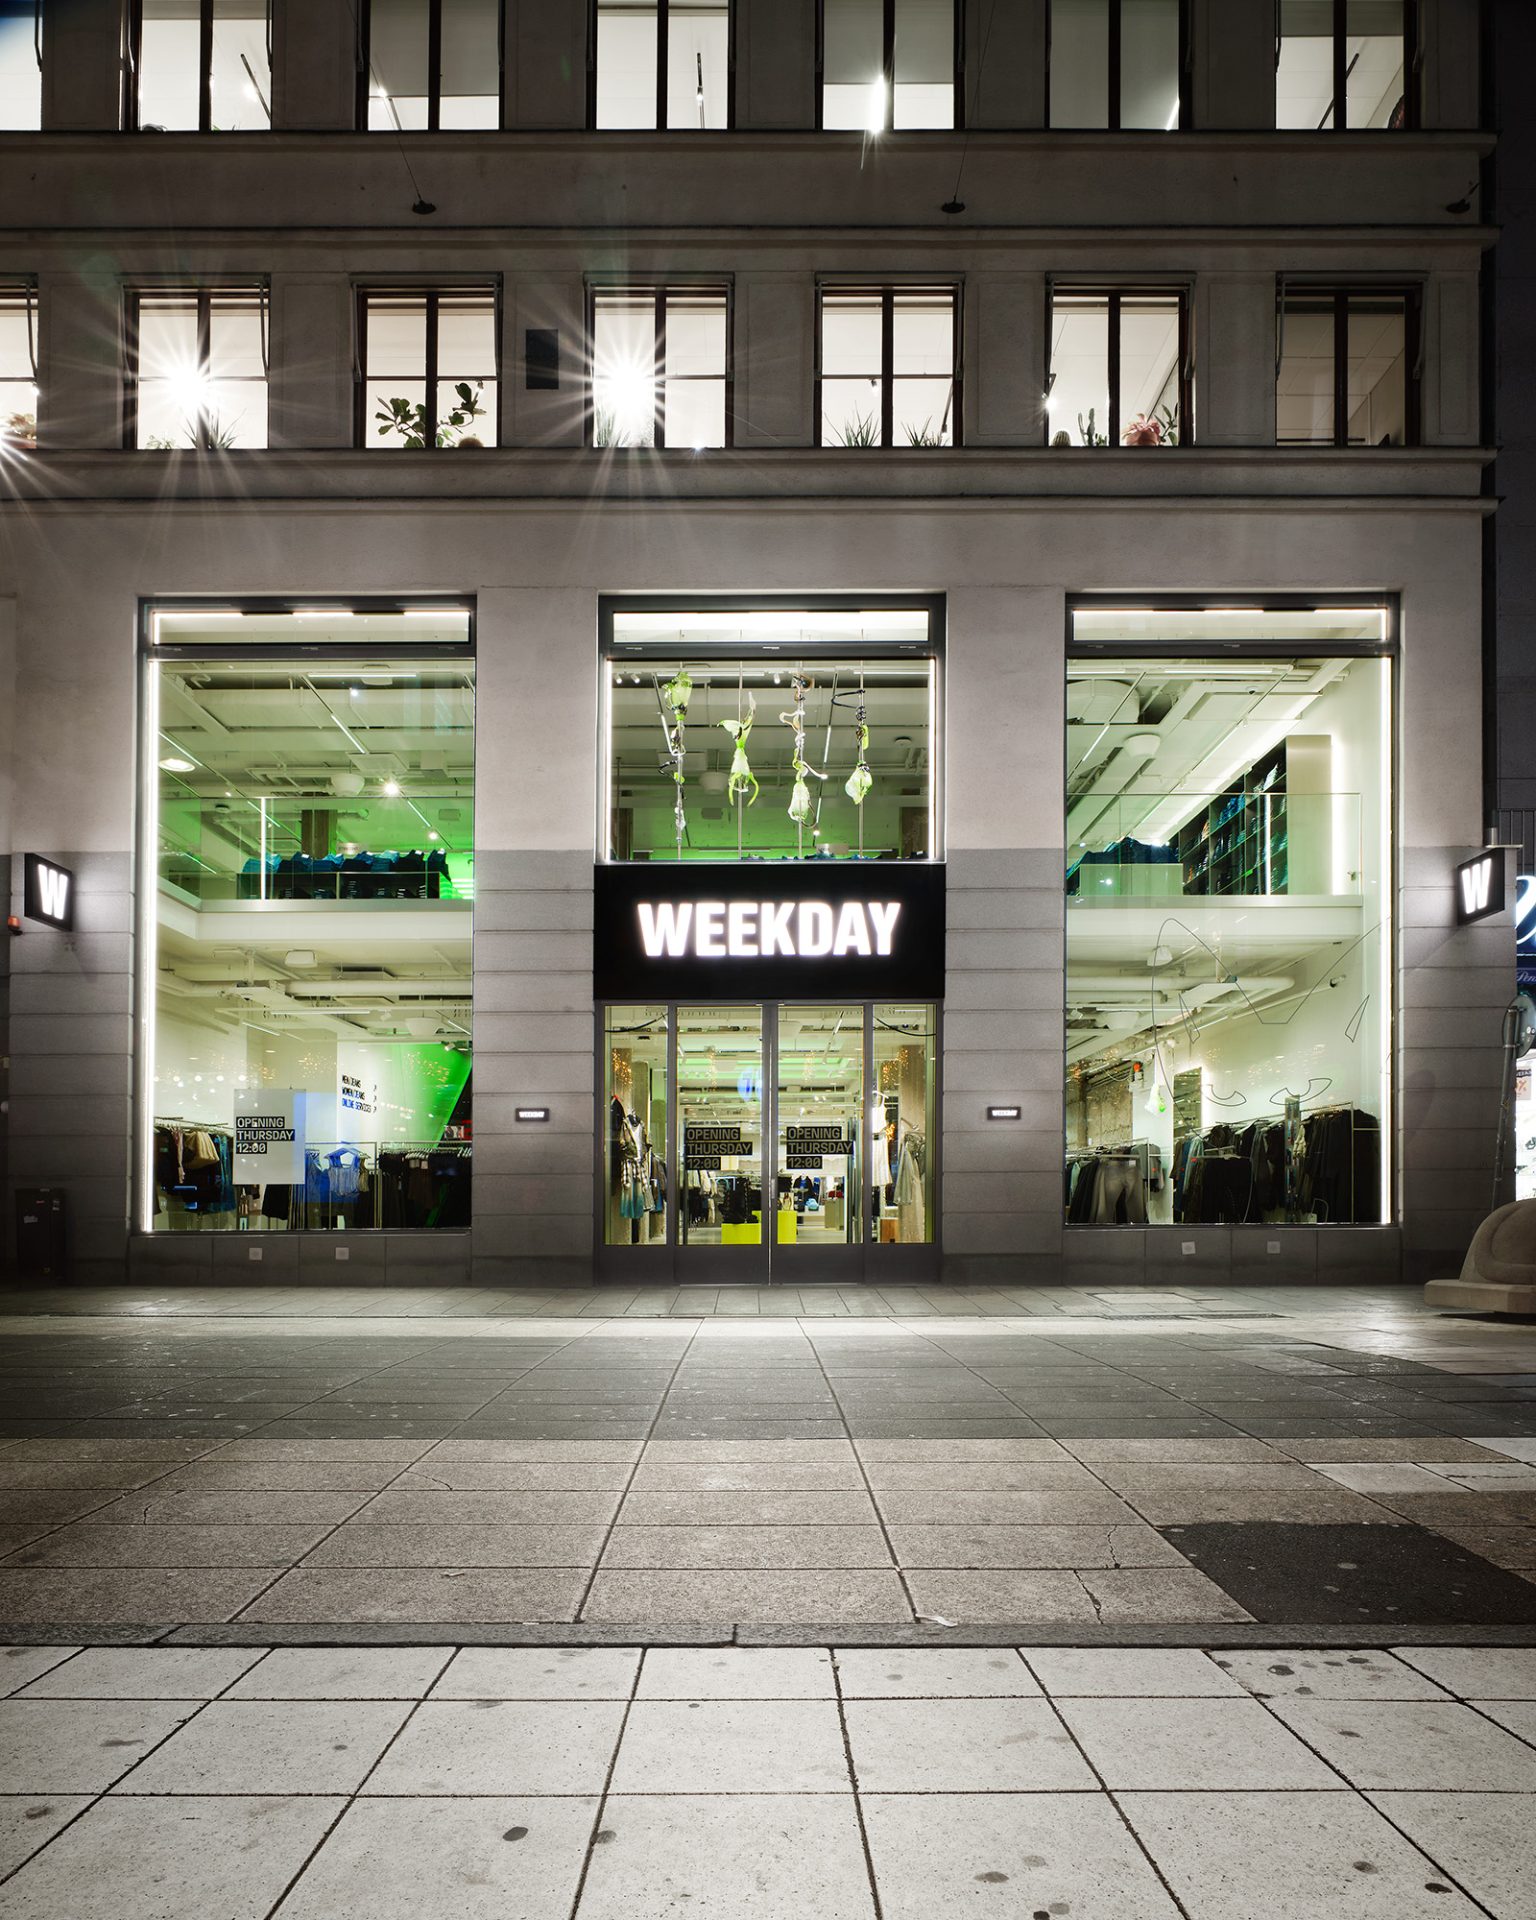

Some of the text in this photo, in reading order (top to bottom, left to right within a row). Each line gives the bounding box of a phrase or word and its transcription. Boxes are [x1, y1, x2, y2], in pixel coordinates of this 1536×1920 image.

[37, 863, 69, 920] W
[1461, 858, 1492, 914] W
[637, 902, 901, 956] WEEKDAY
[237, 1117, 284, 1128] OPENING
[237, 1130, 294, 1141] THURSDAY
[687, 1128, 739, 1140] OPENING
[788, 1127, 840, 1139] OPENING
[237, 1143, 266, 1153] 12:00
[687, 1143, 751, 1154] THURSDAY
[788, 1142, 852, 1153] THURSDAY
[687, 1158, 720, 1169] 12:00
[788, 1157, 820, 1168] 12:00
